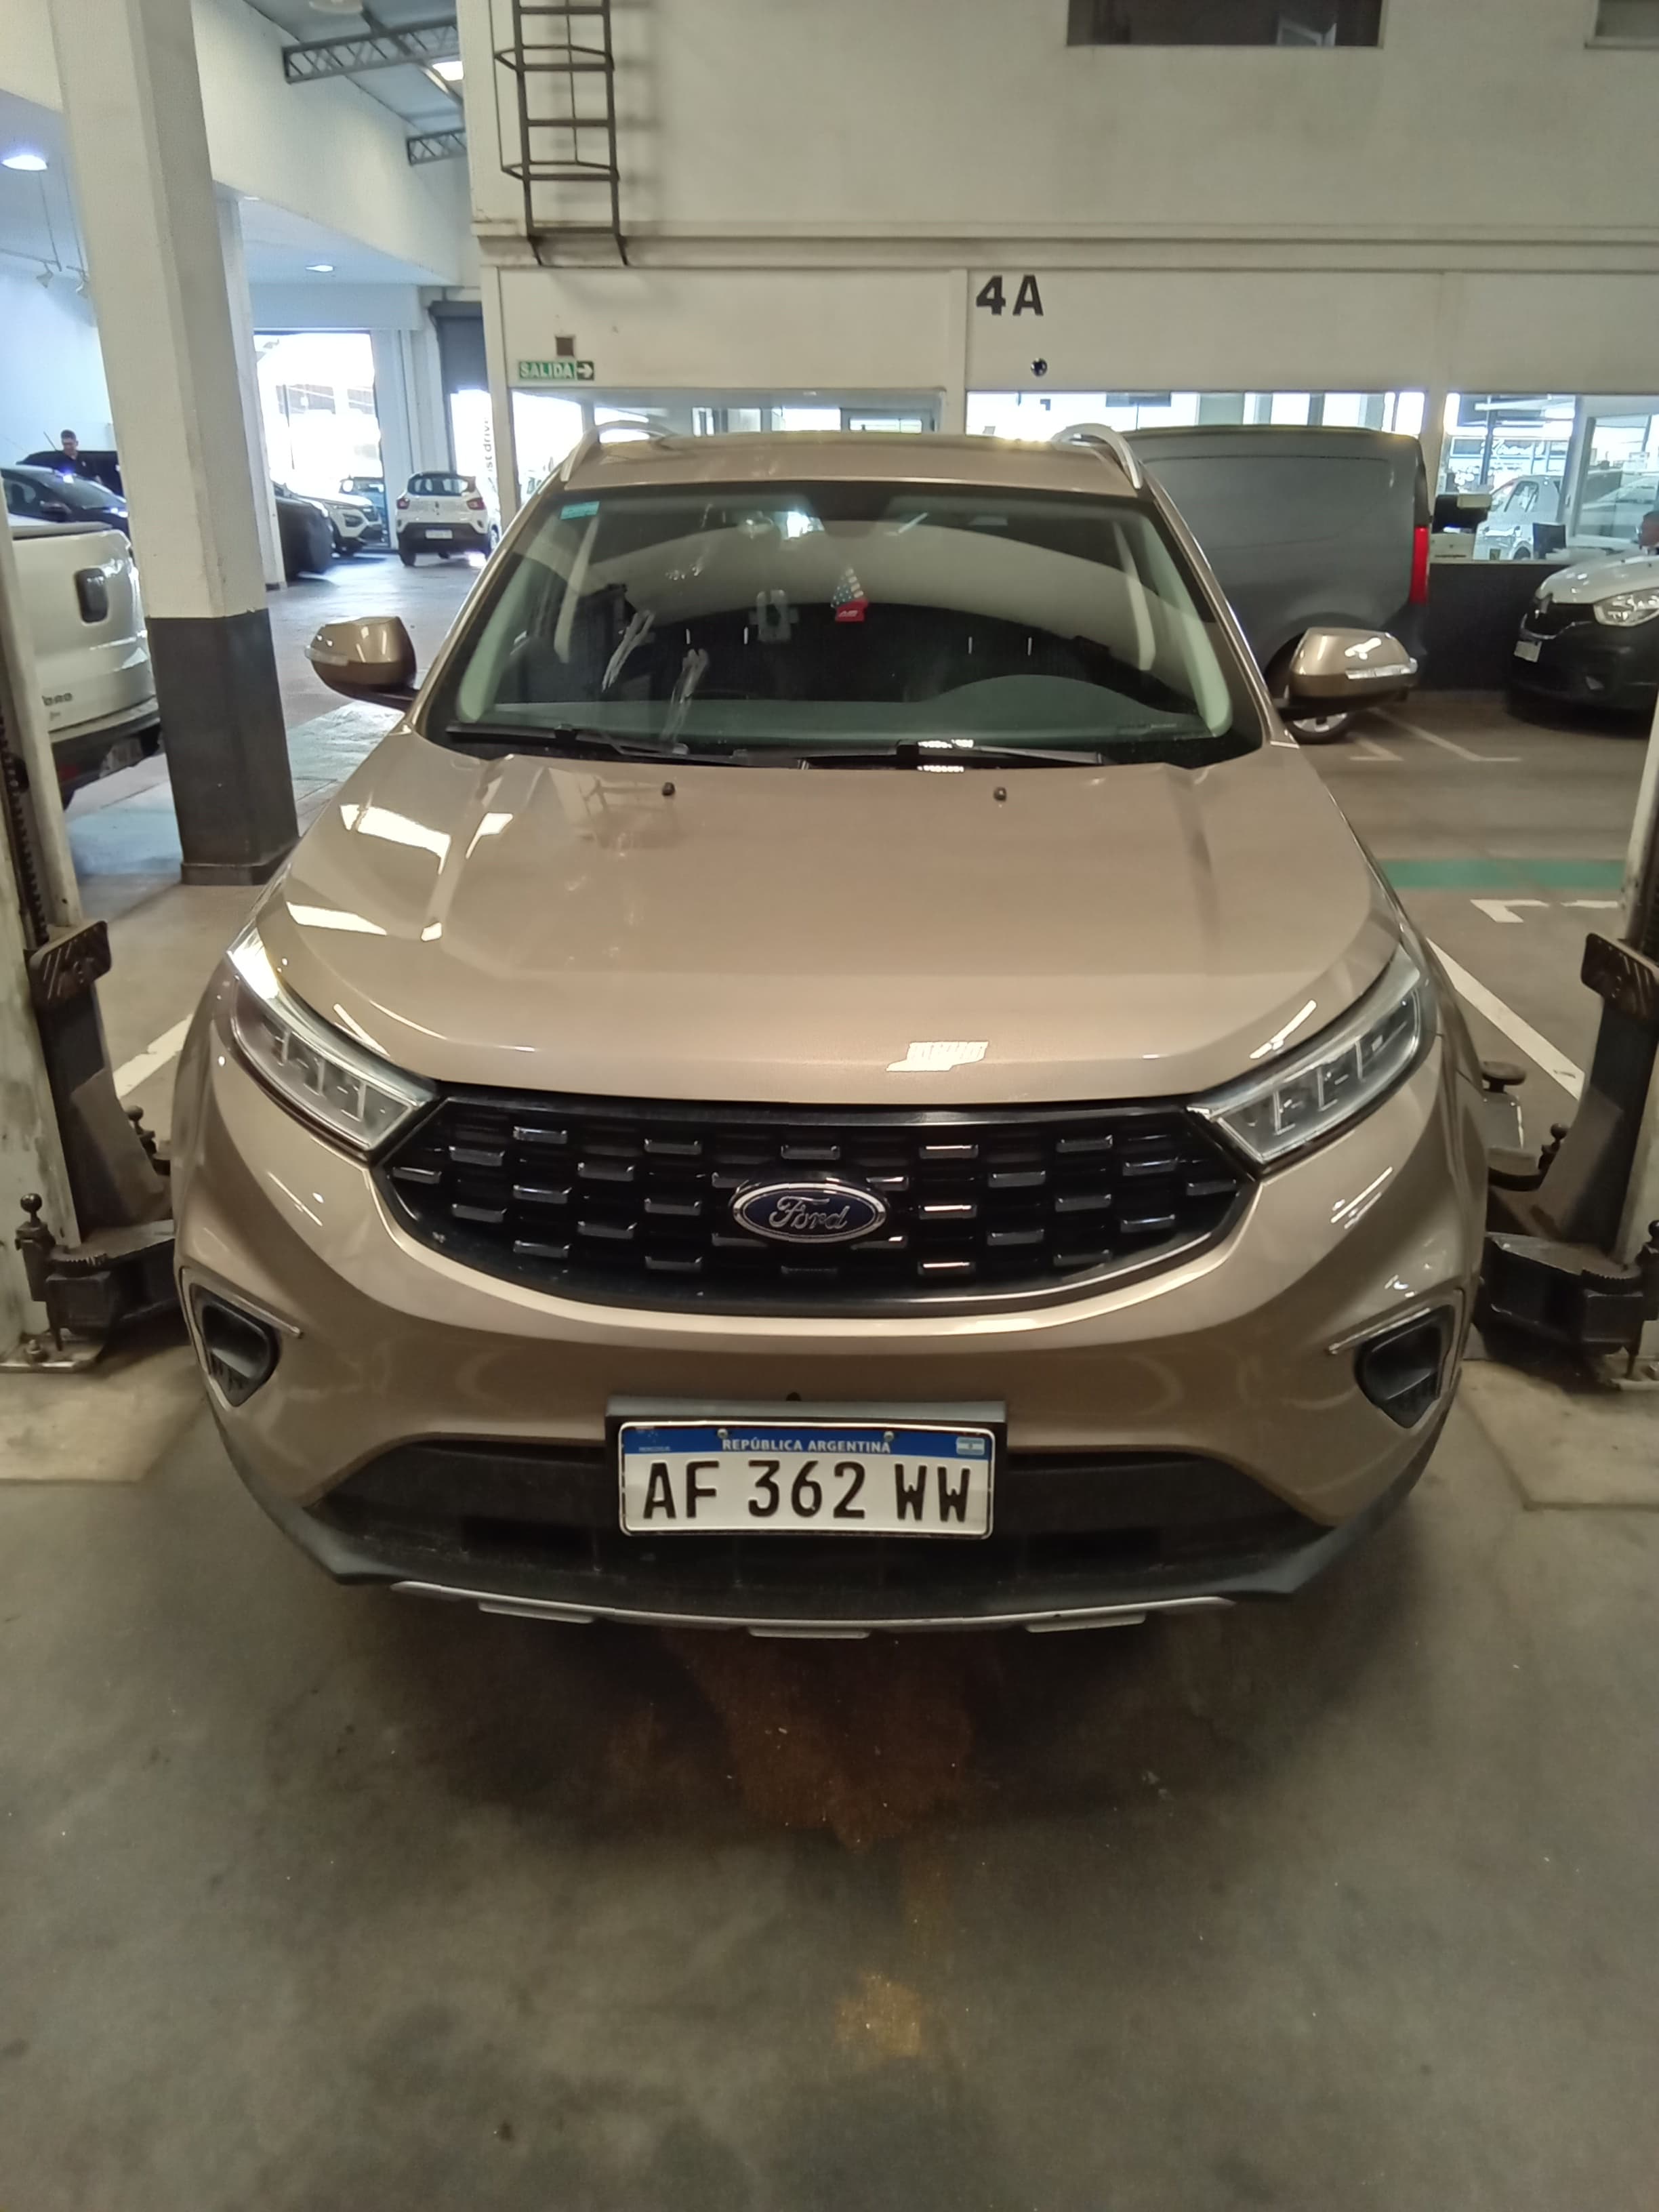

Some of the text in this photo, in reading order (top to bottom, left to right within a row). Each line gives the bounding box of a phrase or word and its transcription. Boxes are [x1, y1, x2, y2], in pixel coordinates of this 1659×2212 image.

[976, 274, 1044, 316] 4A
[520, 362, 574, 378] SALIDA
[768, 1195, 851, 1229] Ford
[722, 1436, 891, 1454] REPÚBLICA ARGENTINA
[642, 1460, 971, 1522] AF 362 WW
